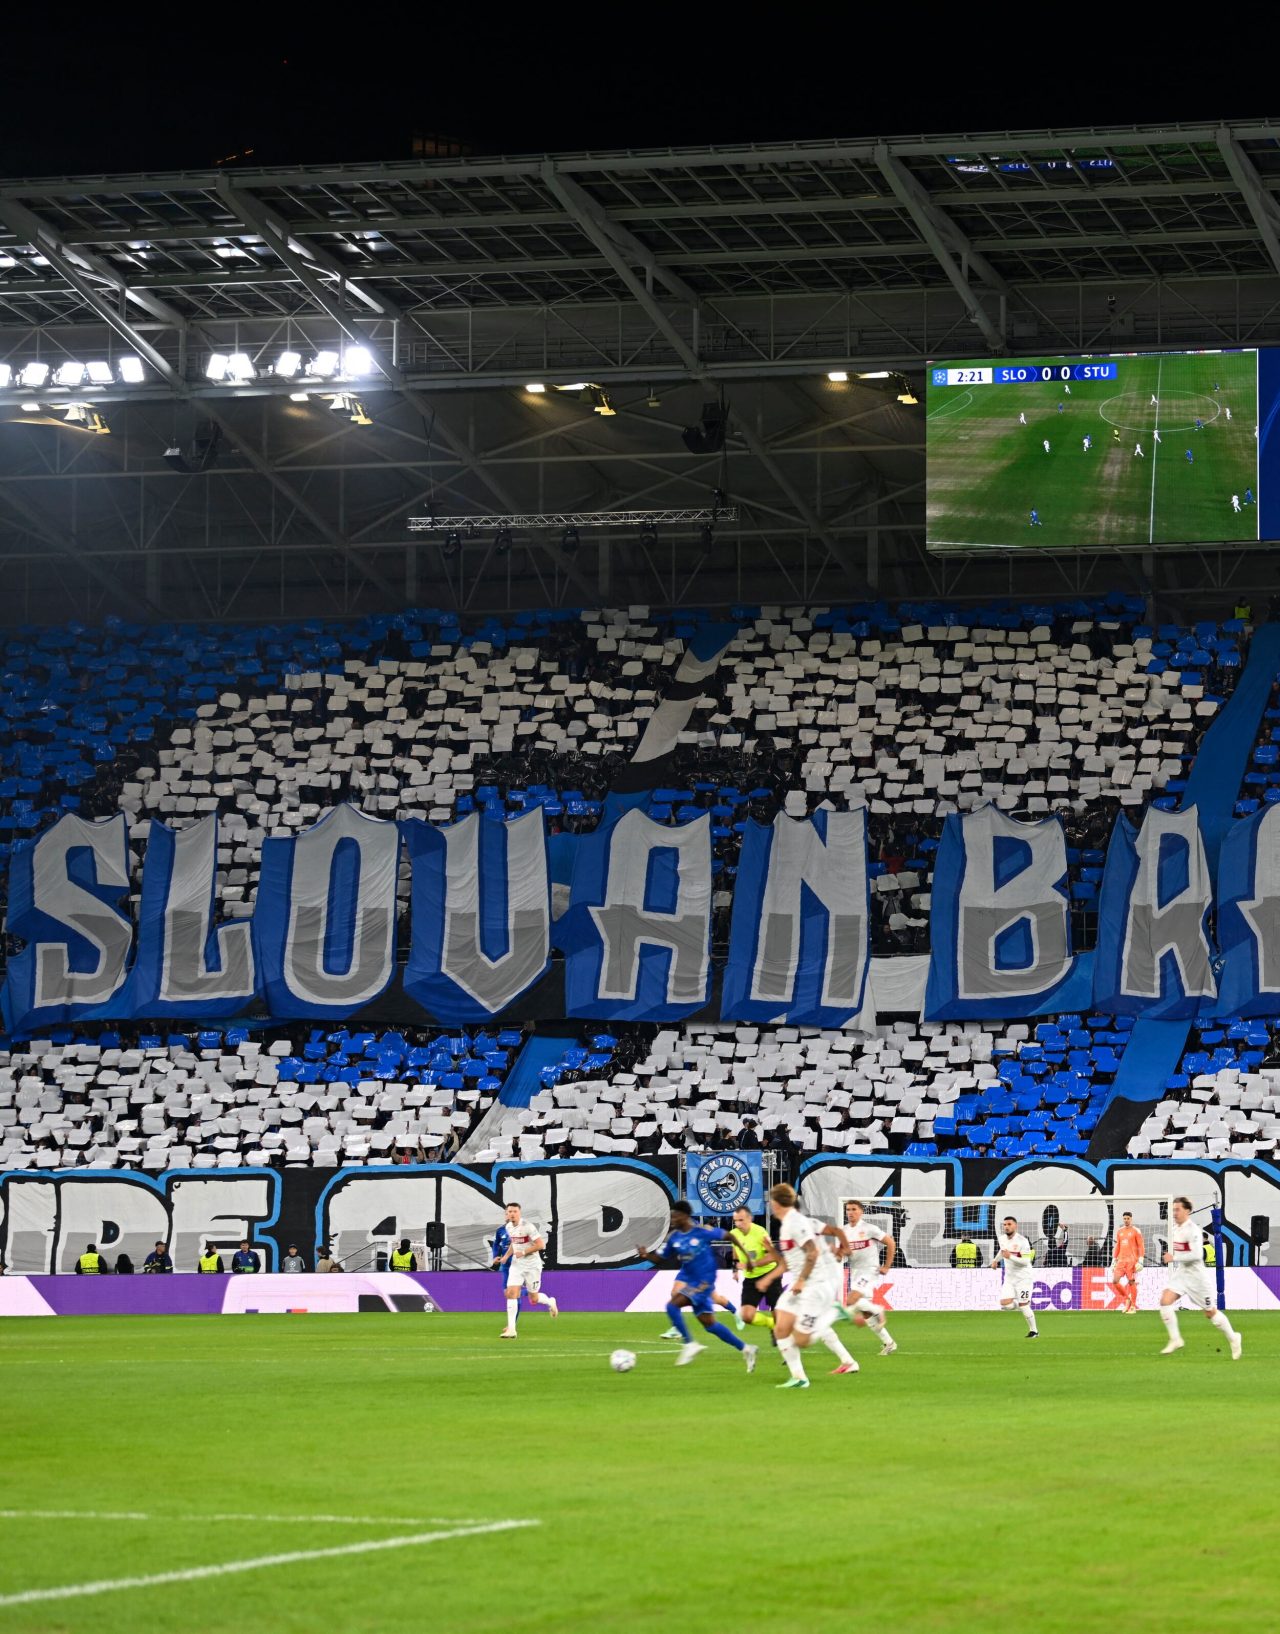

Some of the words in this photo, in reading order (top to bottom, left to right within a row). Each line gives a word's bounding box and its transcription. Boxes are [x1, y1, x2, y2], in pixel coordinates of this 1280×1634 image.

[957, 371, 984, 382] 2:21
[1002, 369, 1027, 380] SLO
[1041, 367, 1051, 381] 0
[1060, 366, 1071, 380] 0
[1083, 366, 1109, 378] STU
[15, 804, 869, 1018] SLOVAN
[699, 1157, 743, 1182] SEKTOR
[700, 1187, 723, 1211] ULTRAS
[725, 1187, 750, 1211] SLOVAN
[0, 1176, 272, 1274] IDE
[325, 1168, 674, 1271] AND
